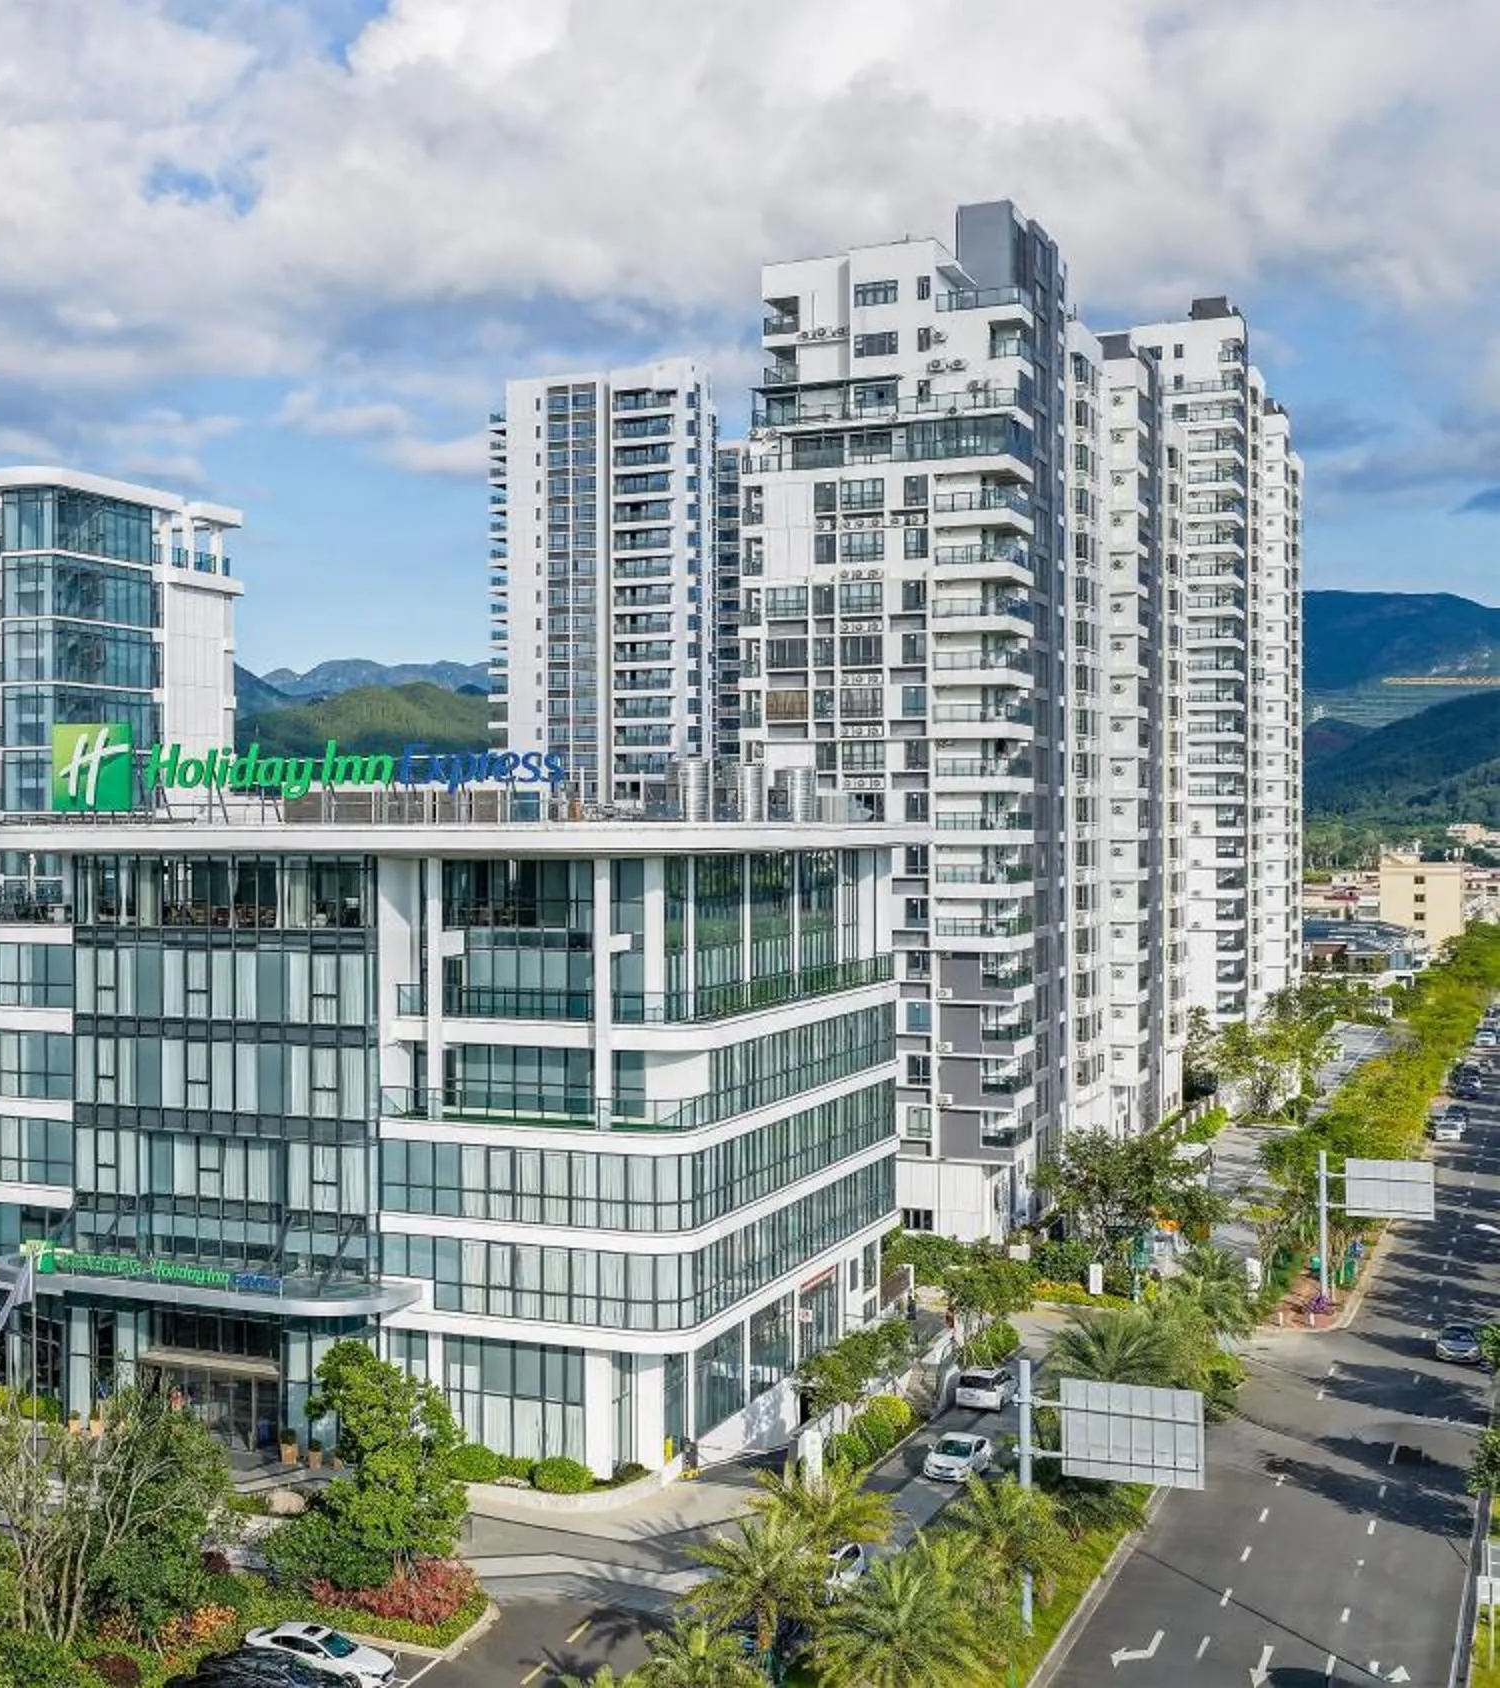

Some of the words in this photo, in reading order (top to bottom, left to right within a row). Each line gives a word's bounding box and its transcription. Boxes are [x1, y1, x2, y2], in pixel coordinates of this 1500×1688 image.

[143, 741, 313, 800] Holiday
[321, 739, 395, 786] Inn
[399, 742, 567, 795] Express
